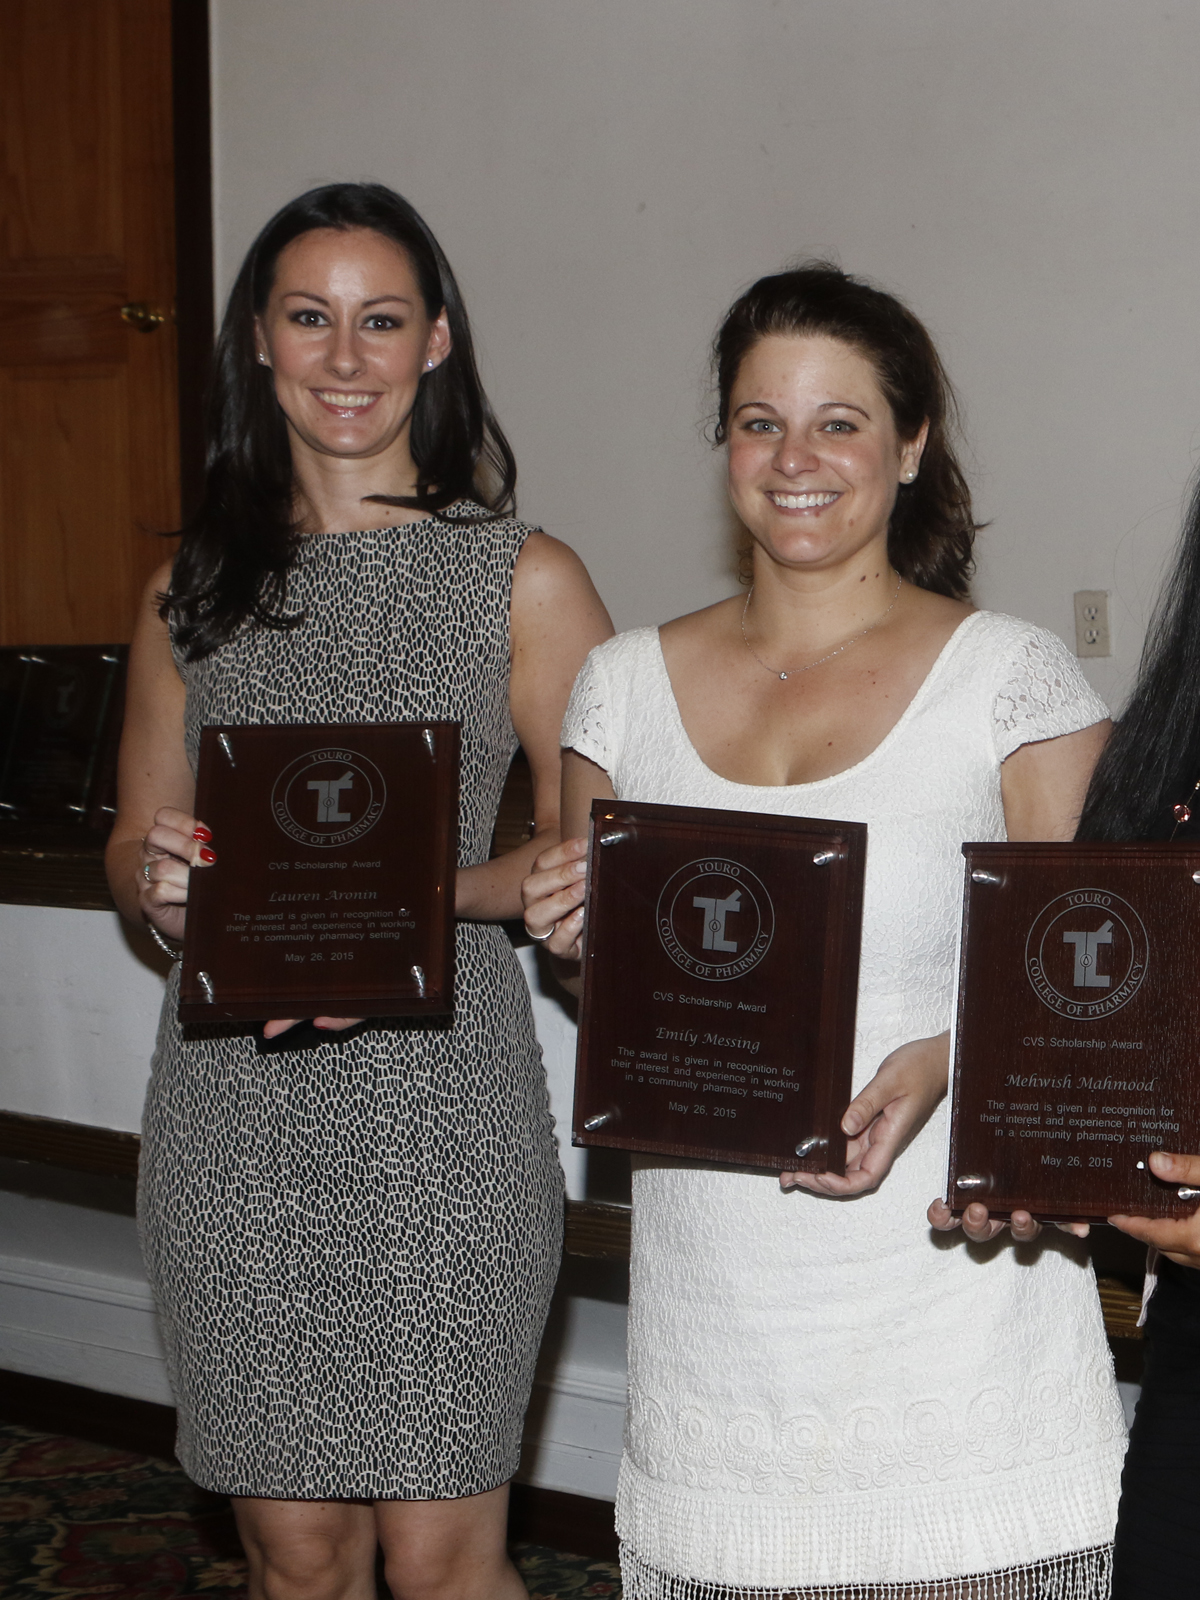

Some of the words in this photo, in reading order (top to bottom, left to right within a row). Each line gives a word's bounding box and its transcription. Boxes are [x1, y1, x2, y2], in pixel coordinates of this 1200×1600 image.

[310, 752, 352, 761] TOURO
[275, 802, 307, 840] COLLEGE
[311, 835, 326, 844] OF
[331, 801, 381, 843] PHARMACY
[268, 862, 289, 871] CVS
[295, 861, 347, 869] Scholarship
[696, 862, 740, 877] TOURO
[268, 892, 320, 902] Lauren
[325, 889, 377, 901] Aronin
[1066, 893, 1111, 906] TOURO
[233, 913, 250, 921] The
[289, 912, 295, 920] is
[301, 912, 325, 921] given
[331, 911, 338, 919] in
[343, 910, 393, 919] recognition
[226, 924, 246, 932] their
[312, 922, 362, 930] experience
[381, 920, 415, 929] working
[241, 934, 248, 942] in
[265, 933, 314, 942] community
[320, 932, 364, 941] pharmacy
[370, 931, 400, 940] setting
[661, 918, 693, 968] COLLEGE
[696, 965, 711, 976] OF
[716, 931, 769, 977] PHARMACY
[285, 954, 305, 963] May
[331, 952, 353, 960] 2015
[1030, 958, 1064, 1009] COLLEGE
[1067, 1004, 1083, 1015] OF
[1088, 961, 1143, 1015] PHARMACY
[653, 991, 673, 1002] CVS
[679, 995, 732, 1010] Scholarship
[737, 1002, 766, 1013] Award
[656, 1027, 698, 1046] Emily
[702, 1033, 760, 1054] Messing
[1023, 1037, 1045, 1047] CVS
[1050, 1038, 1106, 1050] Scholarship
[1111, 1040, 1142, 1049] Award
[618, 1047, 634, 1057] The
[640, 1051, 667, 1060] award
[673, 1054, 679, 1062] is
[685, 1057, 708, 1067] given
[714, 1059, 721, 1067] in
[727, 1062, 777, 1075] recognition
[783, 1067, 795, 1076] for
[611, 1059, 631, 1068] their
[636, 1062, 669, 1073] interest
[674, 1068, 690, 1076] and
[696, 1071, 745, 1083] experience
[751, 1076, 758, 1084] in
[764, 1079, 799, 1091] working
[1005, 1073, 1072, 1089] Mehwish
[1077, 1076, 1158, 1092] Mahmood
[625, 1072, 633, 1081] in
[649, 1076, 698, 1091] community
[703, 1083, 747, 1097] pharmacy
[753, 1090, 783, 1102] setting
[669, 1101, 688, 1114] May
[714, 1107, 736, 1118] 2015
[987, 1100, 1005, 1110] The
[1010, 1102, 1038, 1111] award
[1044, 1103, 1051, 1111] is
[1057, 1103, 1082, 1114] given
[1088, 1105, 1096, 1113] in
[1102, 1105, 1155, 1117] recognition
[1161, 1106, 1174, 1117] for
[980, 1114, 1000, 1123] their
[1005, 1115, 1040, 1124] interest
[1046, 1116, 1063, 1125] and
[1069, 1118, 1122, 1129] experience
[1128, 1120, 1136, 1128] in
[1142, 1120, 1179, 1132] working
[995, 1128, 1003, 1136] in
[1020, 1129, 1071, 1141] community
[1077, 1131, 1124, 1143] pharmacy
[1130, 1134, 1162, 1145] setting
[1041, 1155, 1061, 1167] May
[1089, 1157, 1112, 1168] 2015
